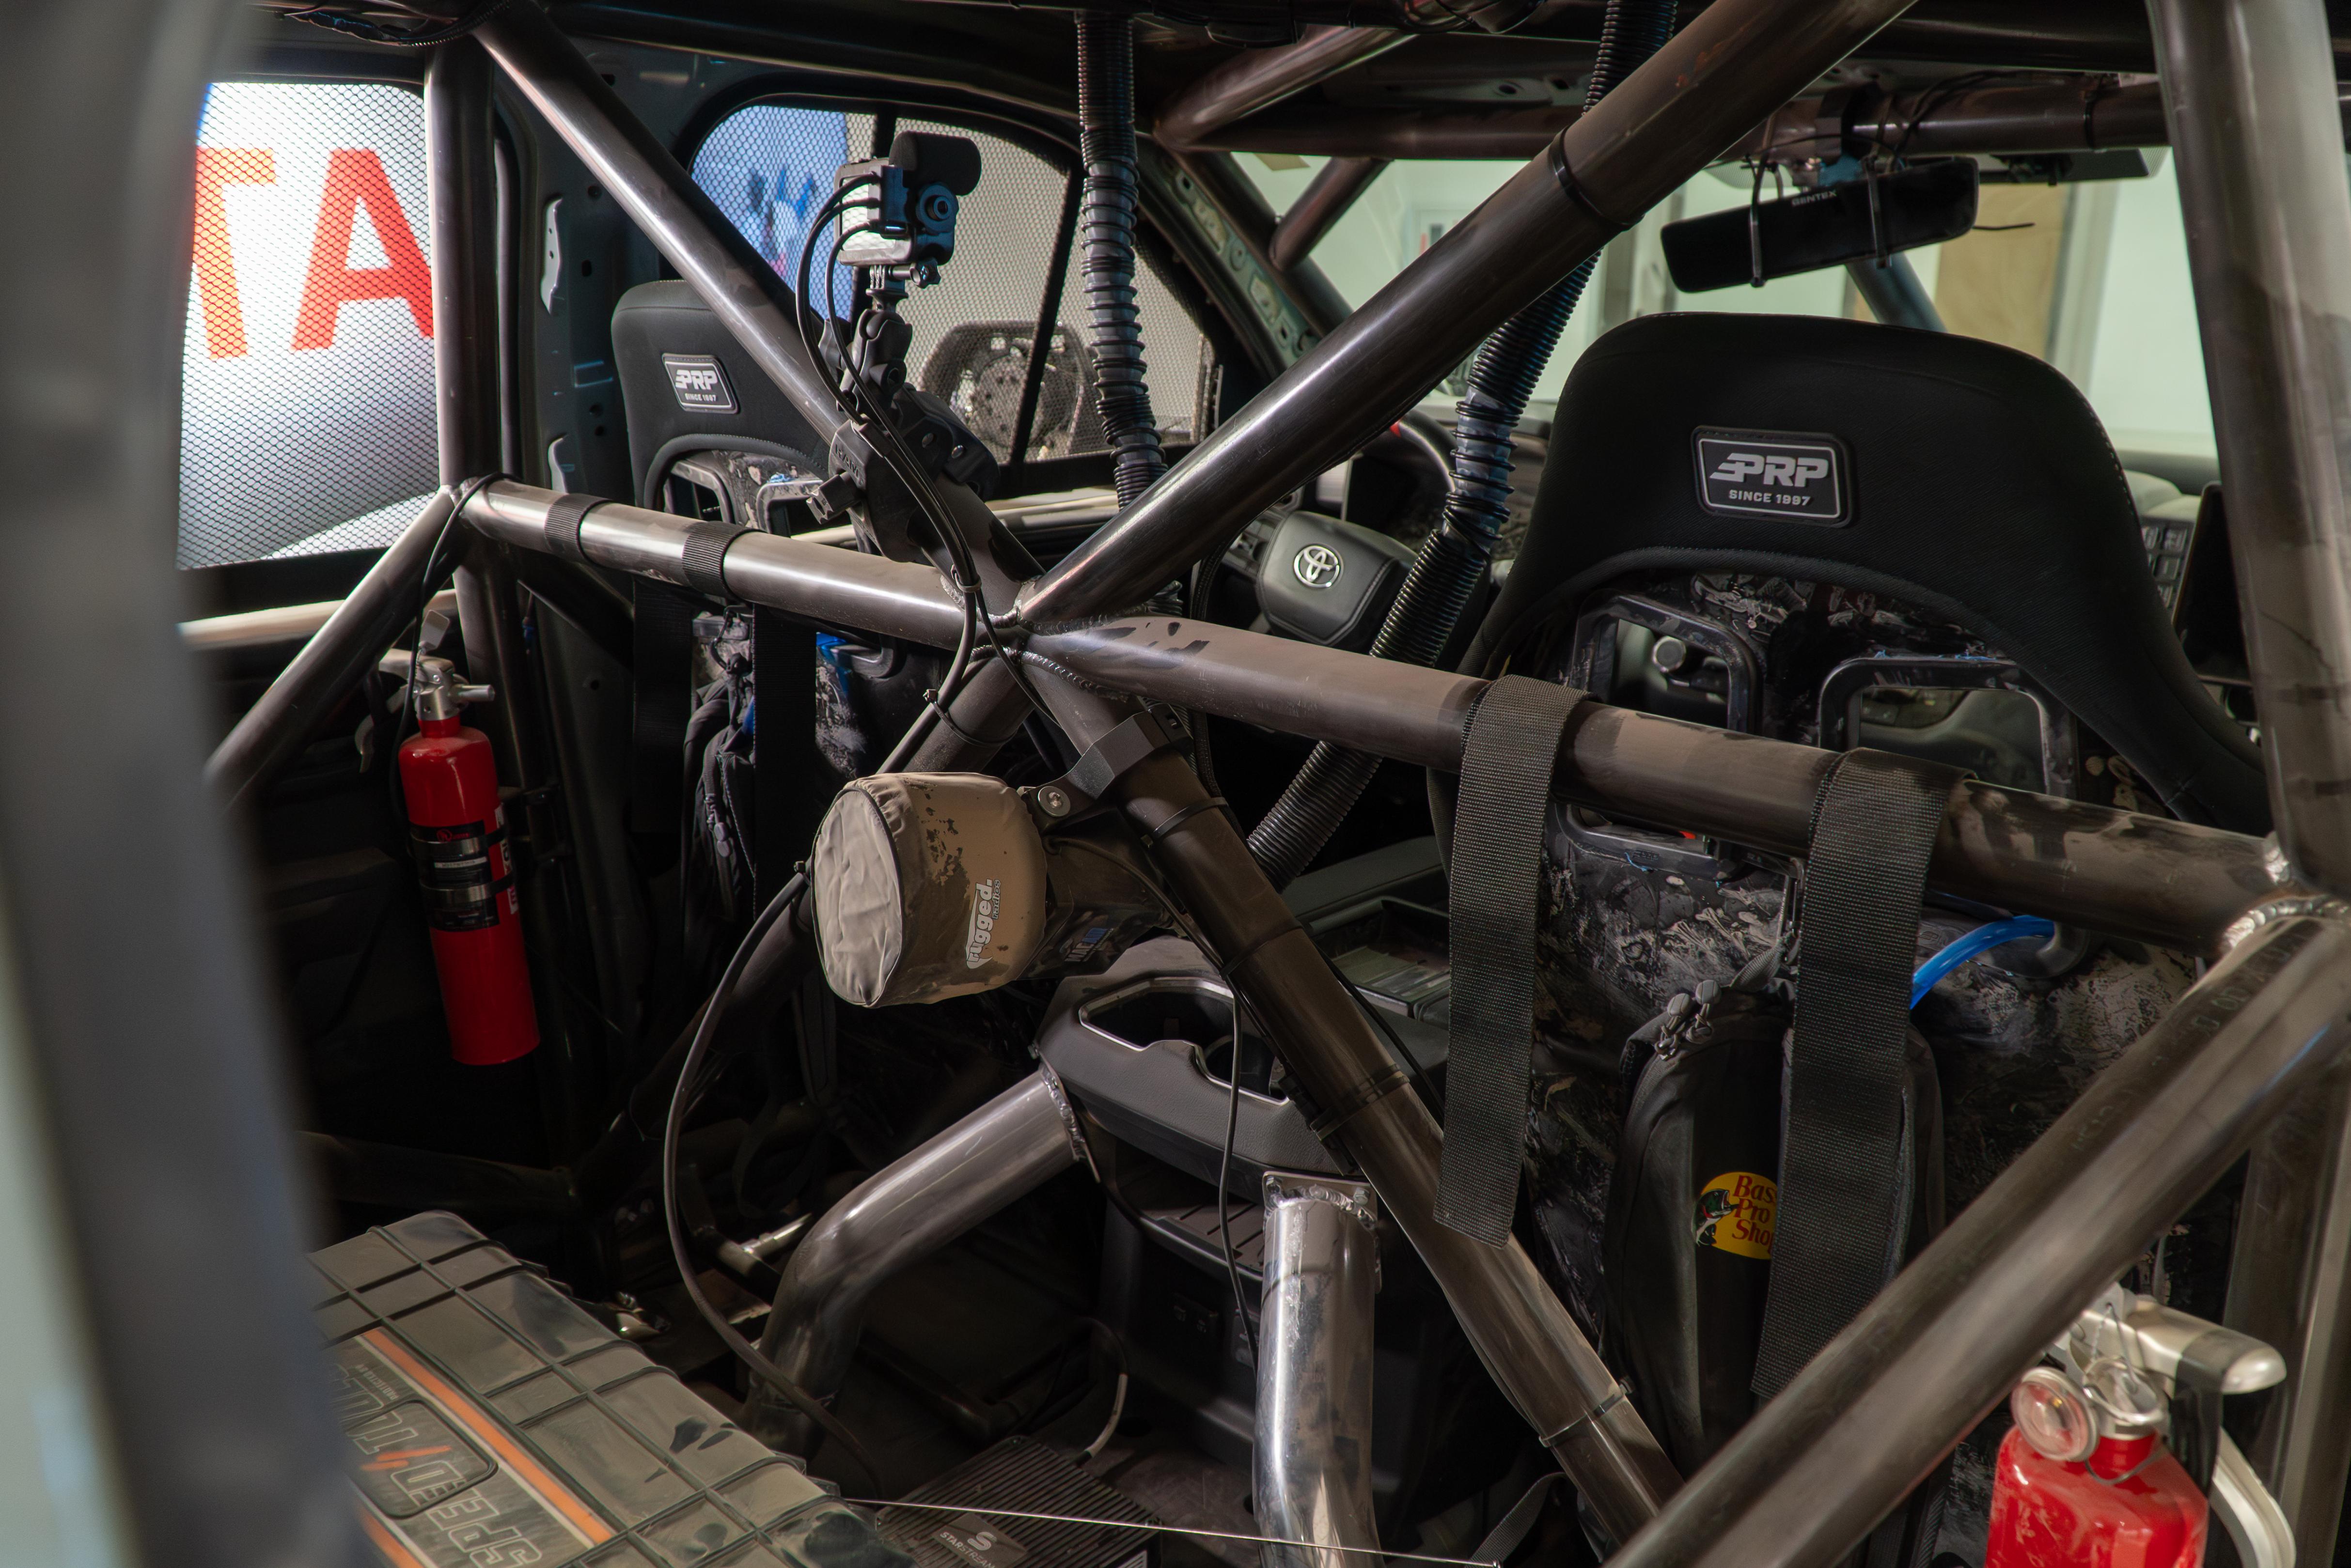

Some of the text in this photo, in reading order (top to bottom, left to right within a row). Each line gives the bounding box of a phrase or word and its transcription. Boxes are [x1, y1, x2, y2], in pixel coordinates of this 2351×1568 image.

[675, 369, 718, 390] PRP
[684, 393, 703, 401] SINCE
[1709, 452, 1829, 487] PRP
[1729, 489, 1811, 506] SINCE 1997
[992, 879, 1001, 920] radios
[1733, 1175, 1777, 1204] Bas
[1734, 1197, 1770, 1224] Pro
[390, 1460, 543, 1568] SPEED
